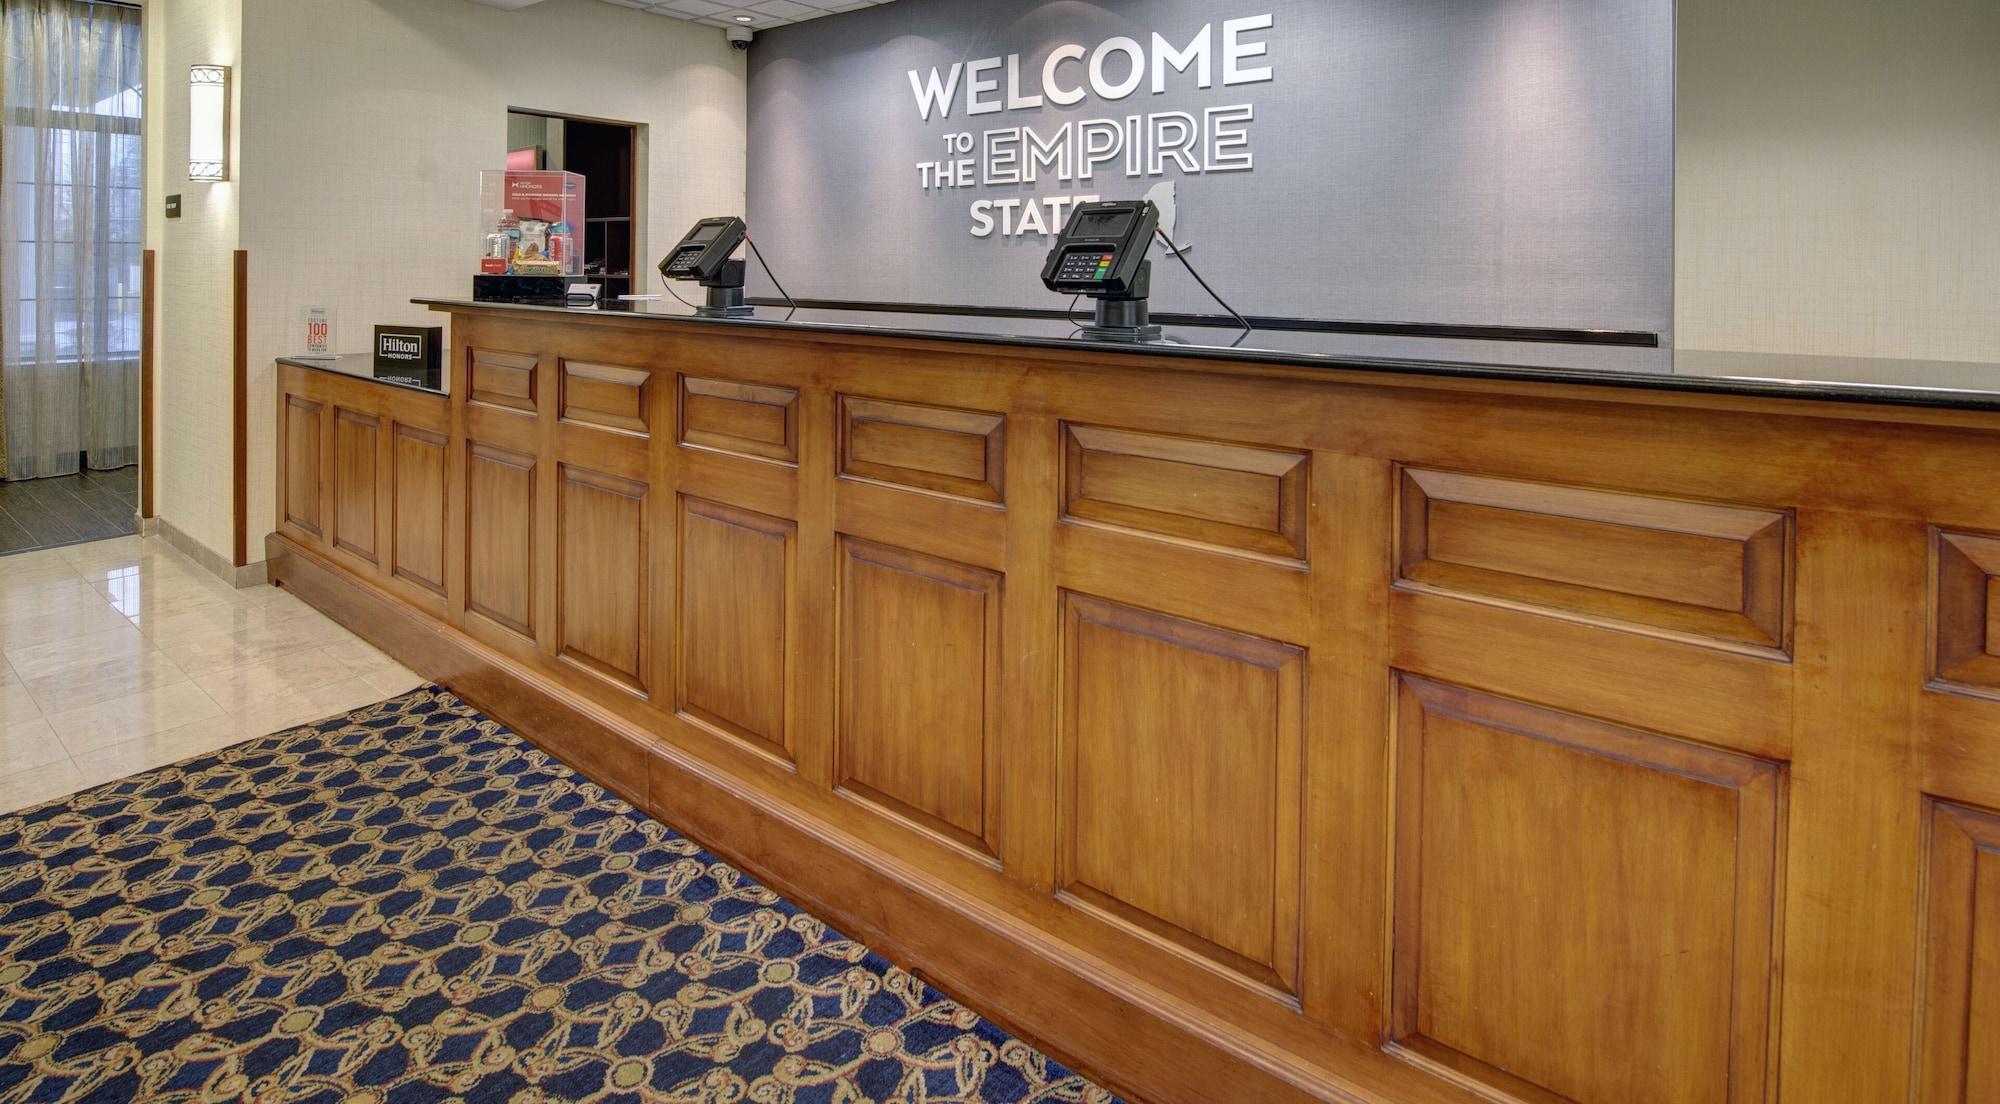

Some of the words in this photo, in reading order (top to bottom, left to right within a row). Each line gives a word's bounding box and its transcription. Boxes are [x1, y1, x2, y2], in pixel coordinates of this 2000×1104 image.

[907, 13, 1274, 121] WELCOME
[917, 159, 976, 188] THE
[983, 103, 1254, 185] EMPIRE
[943, 132, 975, 154] TO
[969, 195, 1100, 237] STAT
[307, 335, 328, 344] BEST
[308, 323, 328, 335] 100
[383, 338, 418, 352] Hilton
